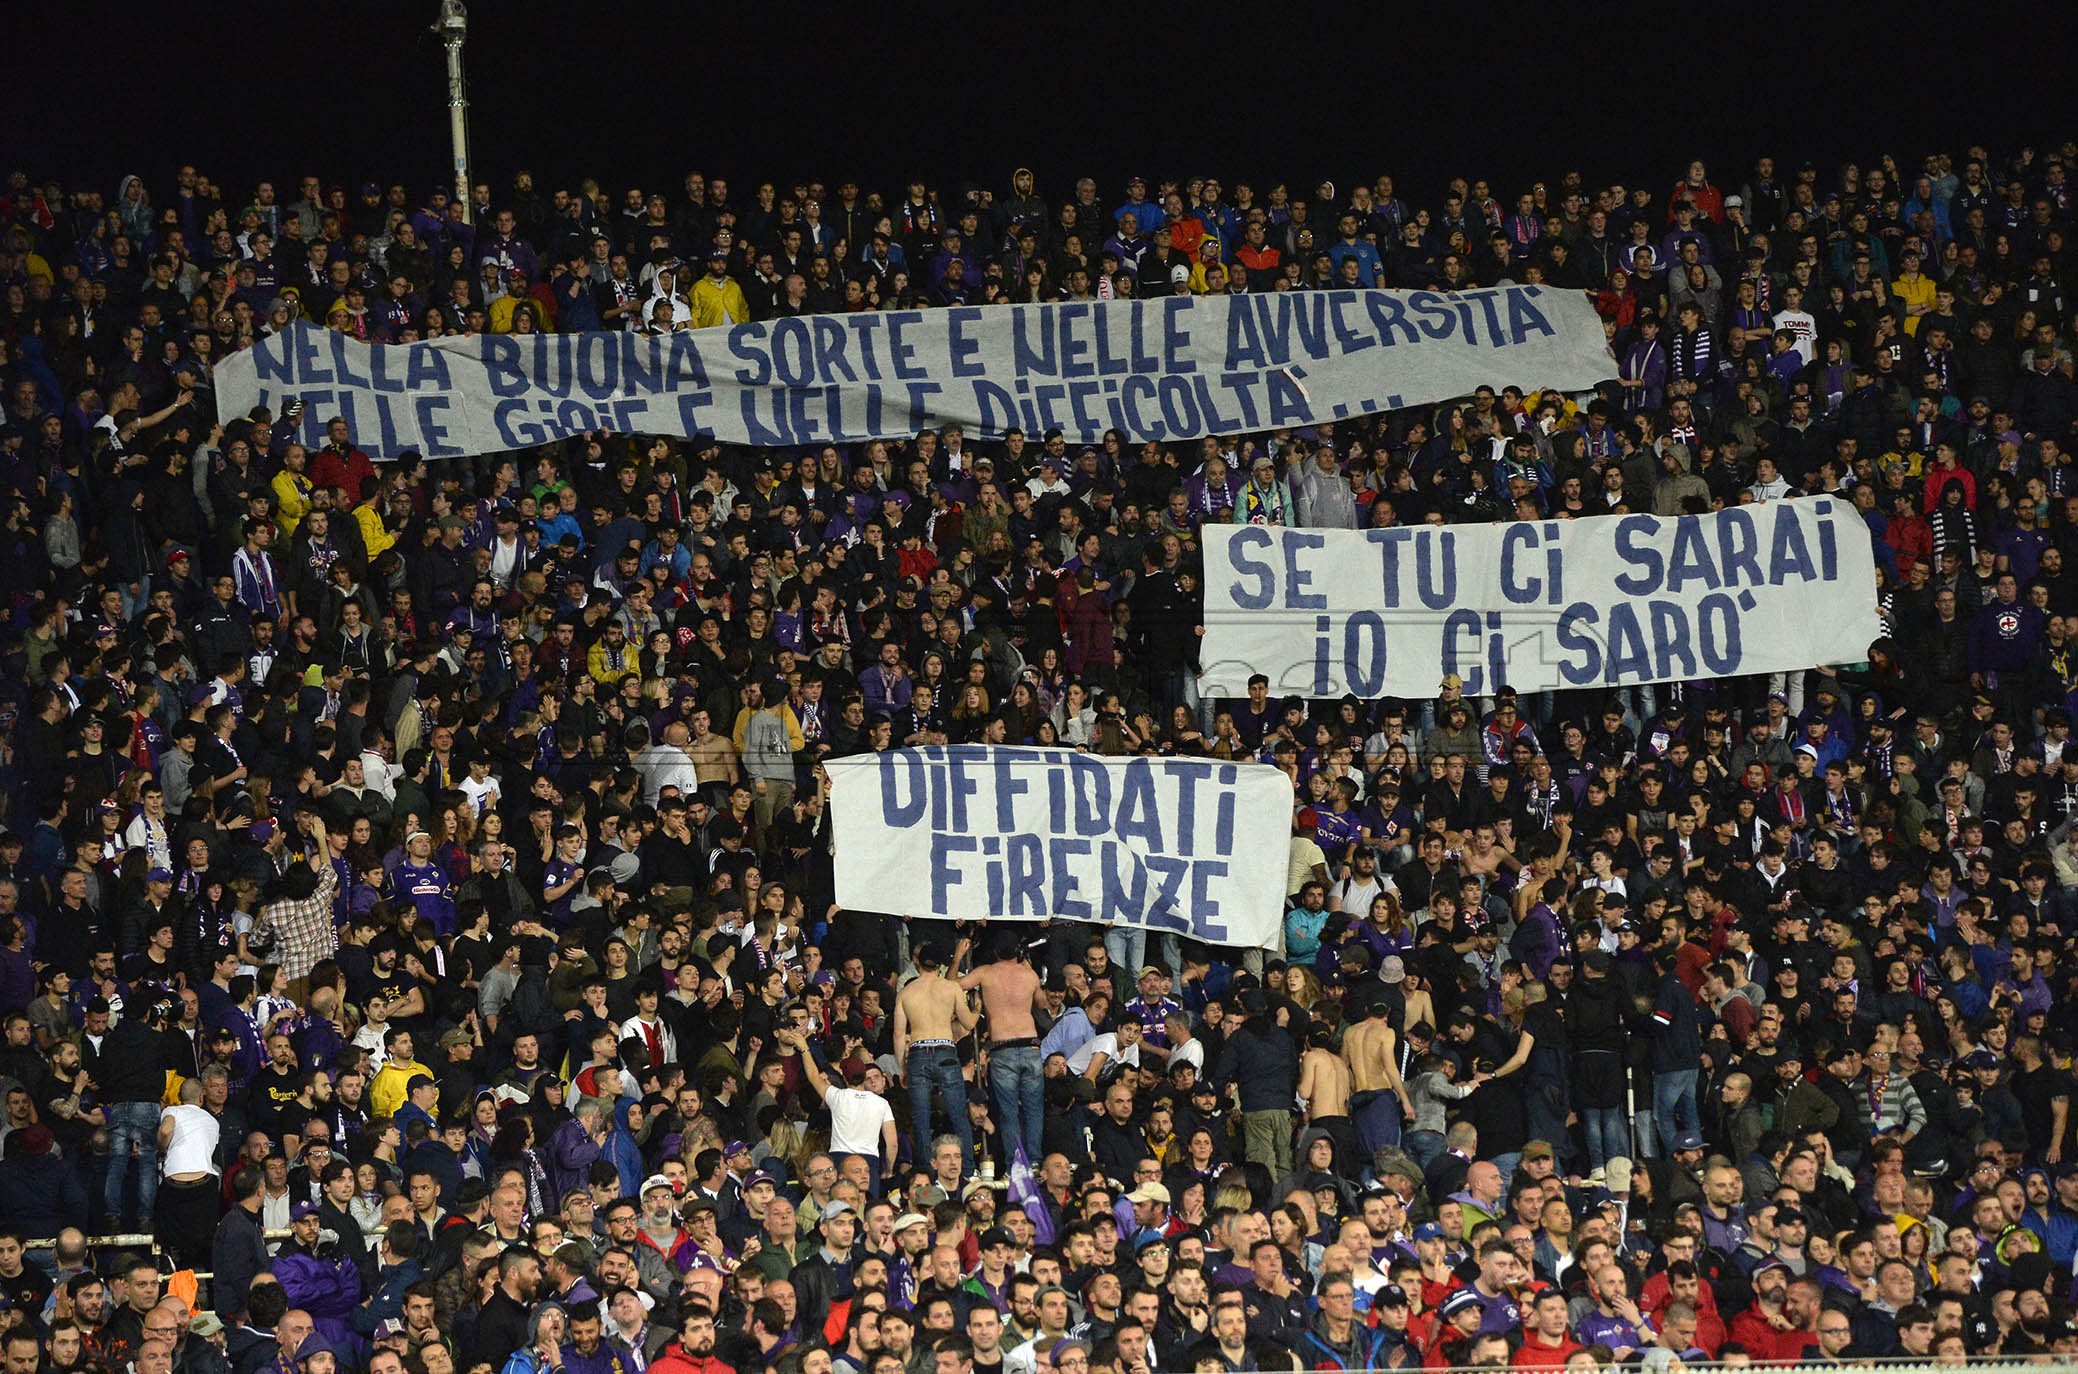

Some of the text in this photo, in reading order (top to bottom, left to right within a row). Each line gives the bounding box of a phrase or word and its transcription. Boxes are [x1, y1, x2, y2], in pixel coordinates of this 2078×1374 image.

[252, 321, 452, 392] NELLA
[481, 331, 710, 399] BUONA
[728, 312, 929, 388] SORTE
[947, 307, 986, 378] E
[1012, 297, 1197, 378] NELLE
[1227, 526, 1328, 610] SE
[1367, 529, 1457, 610] TU
[1317, 826, 1344, 844] OYOTA
